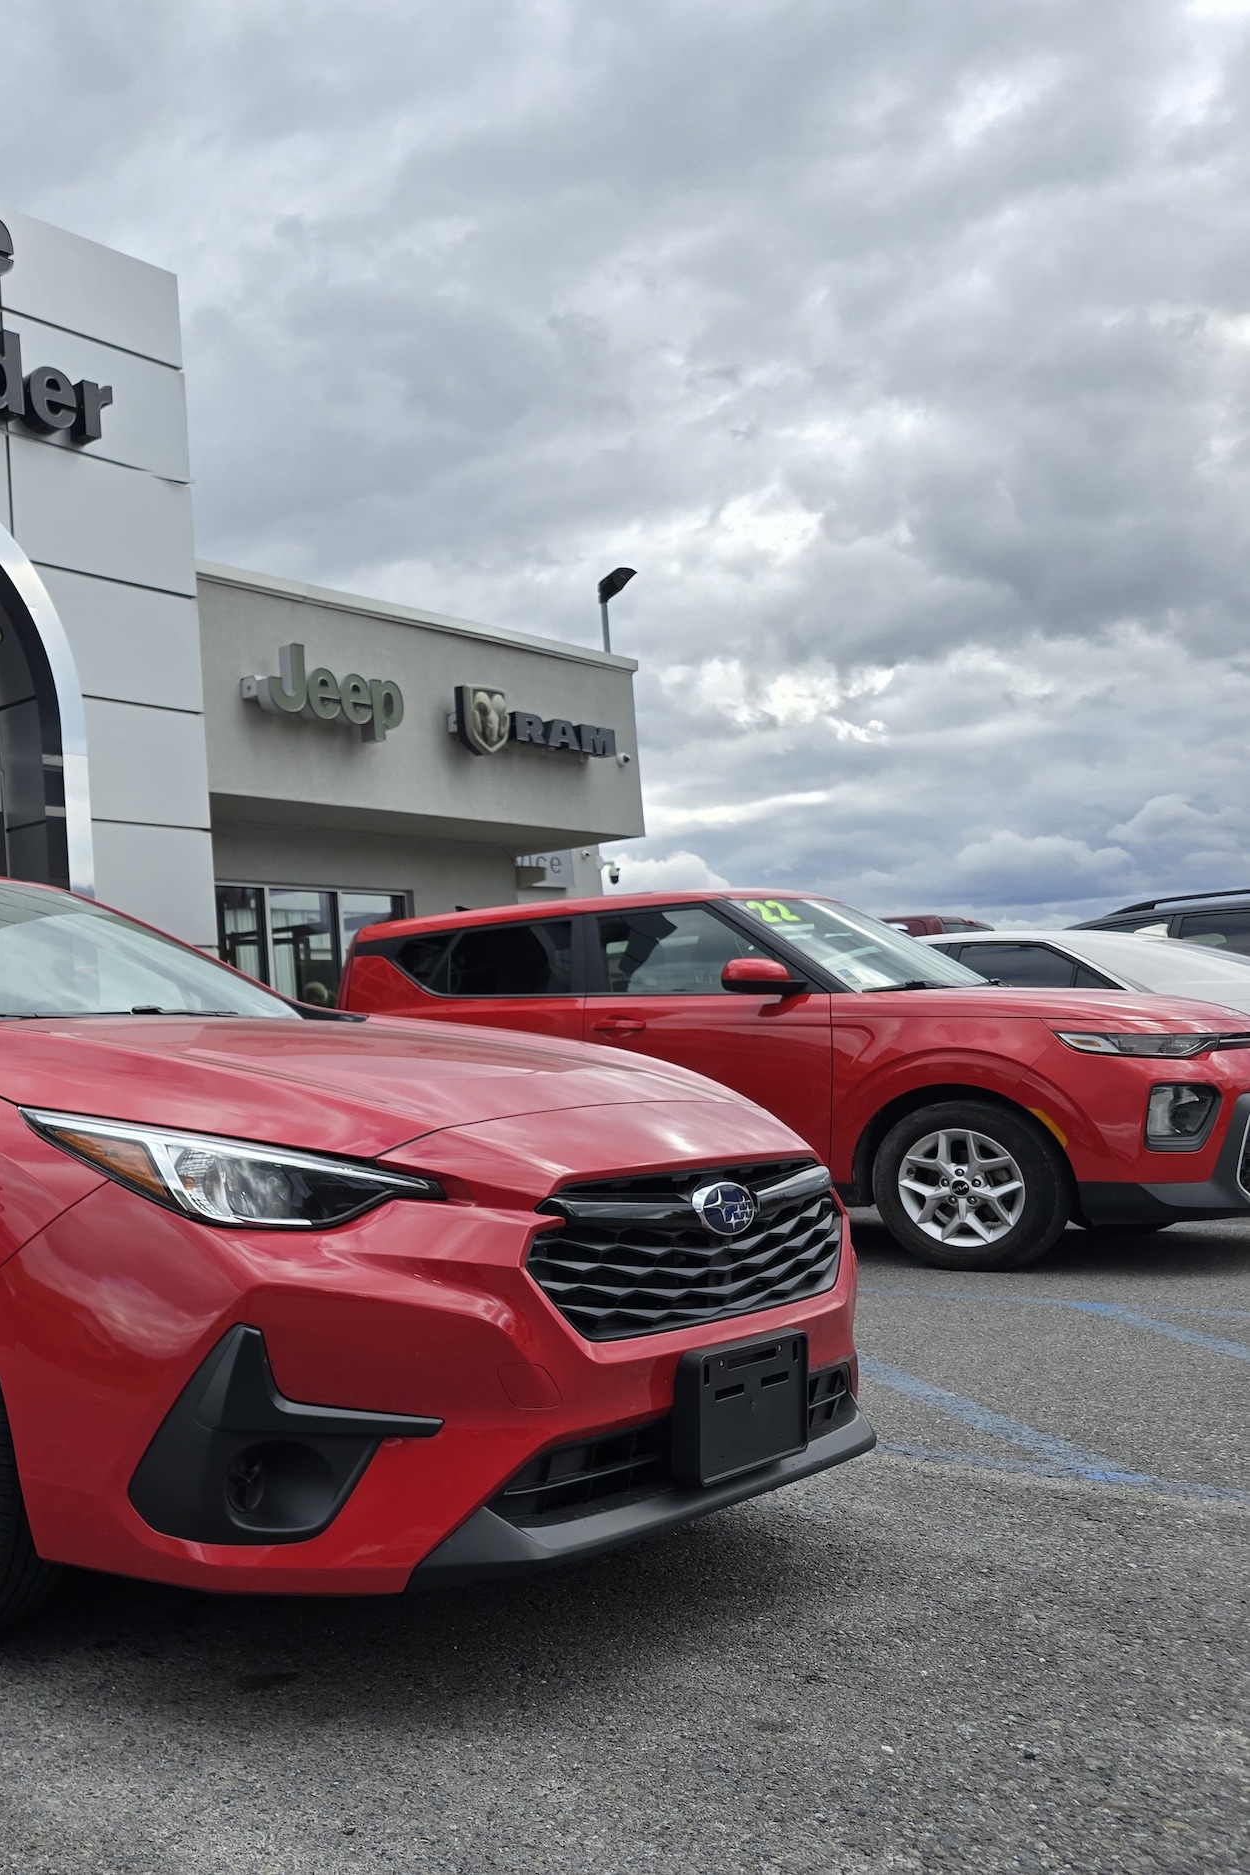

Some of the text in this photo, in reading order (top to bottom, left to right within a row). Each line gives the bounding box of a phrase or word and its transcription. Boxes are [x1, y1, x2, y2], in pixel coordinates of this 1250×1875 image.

[256, 643, 405, 743] Jeep
[508, 711, 616, 758] RAM
[746, 900, 801, 923] 22
